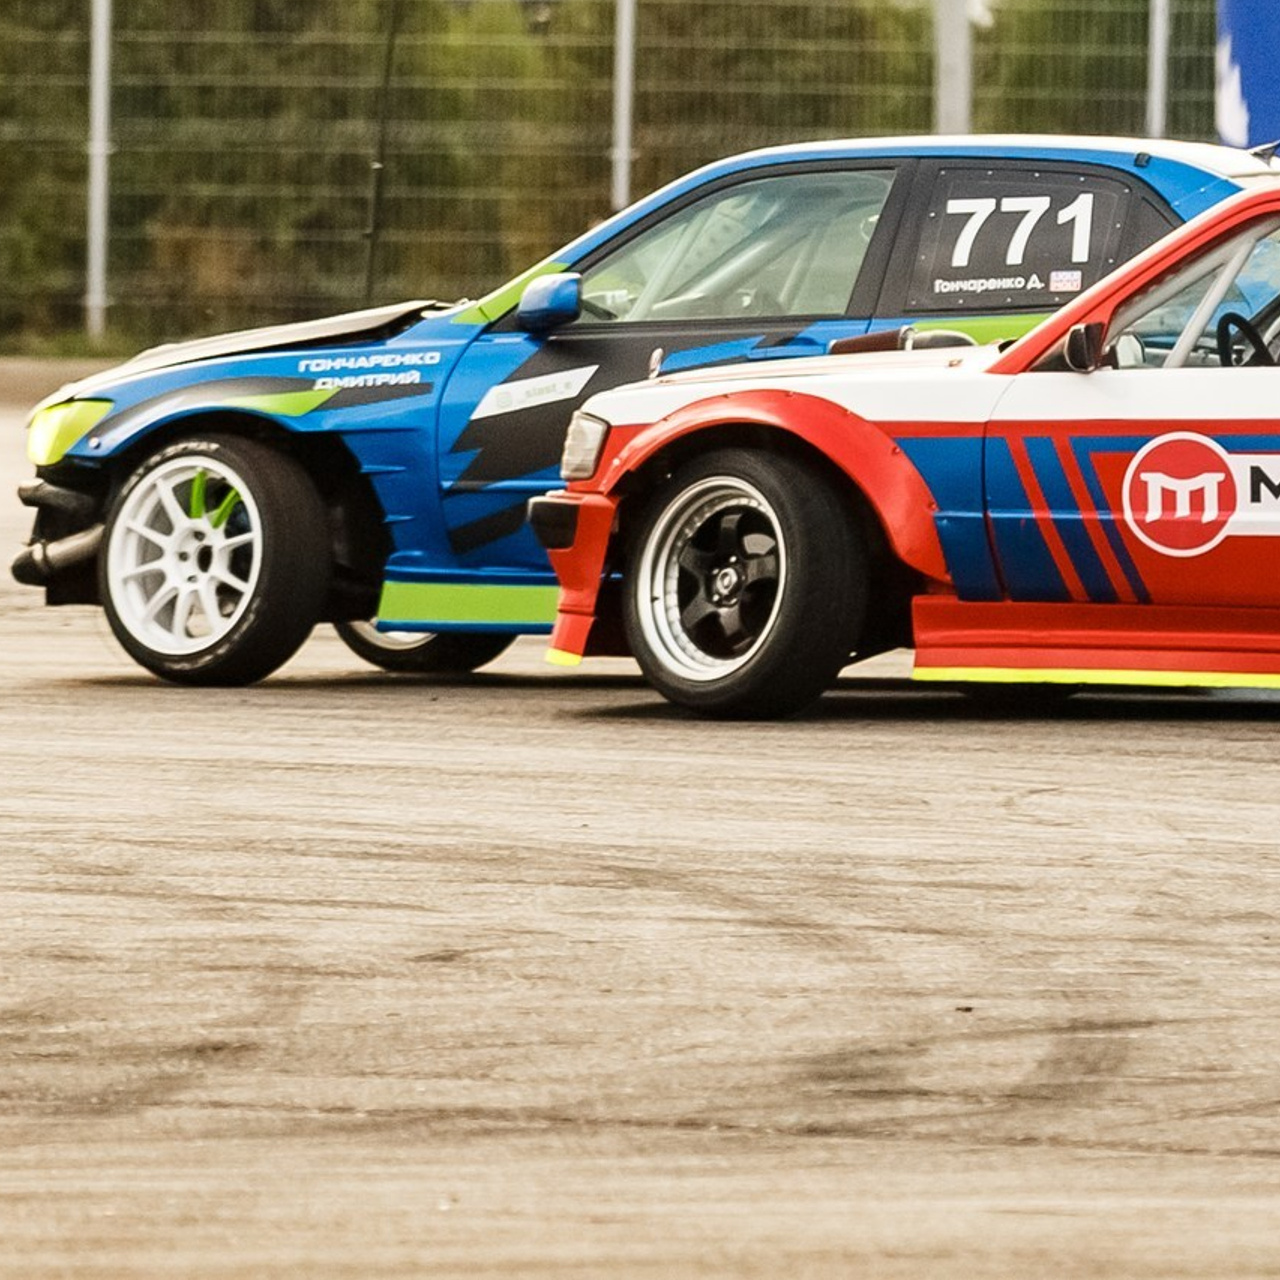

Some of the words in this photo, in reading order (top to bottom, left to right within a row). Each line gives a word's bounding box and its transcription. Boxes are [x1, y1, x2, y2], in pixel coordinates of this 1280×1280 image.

[946, 193, 1094, 267] 771
[933, 277, 1026, 294] Гончаренко
[1026, 273, 1046, 290] Д.
[298, 351, 441, 373] ГОНЧАРЕНКО
[313, 369, 421, 391] ДМИТРИЙ
